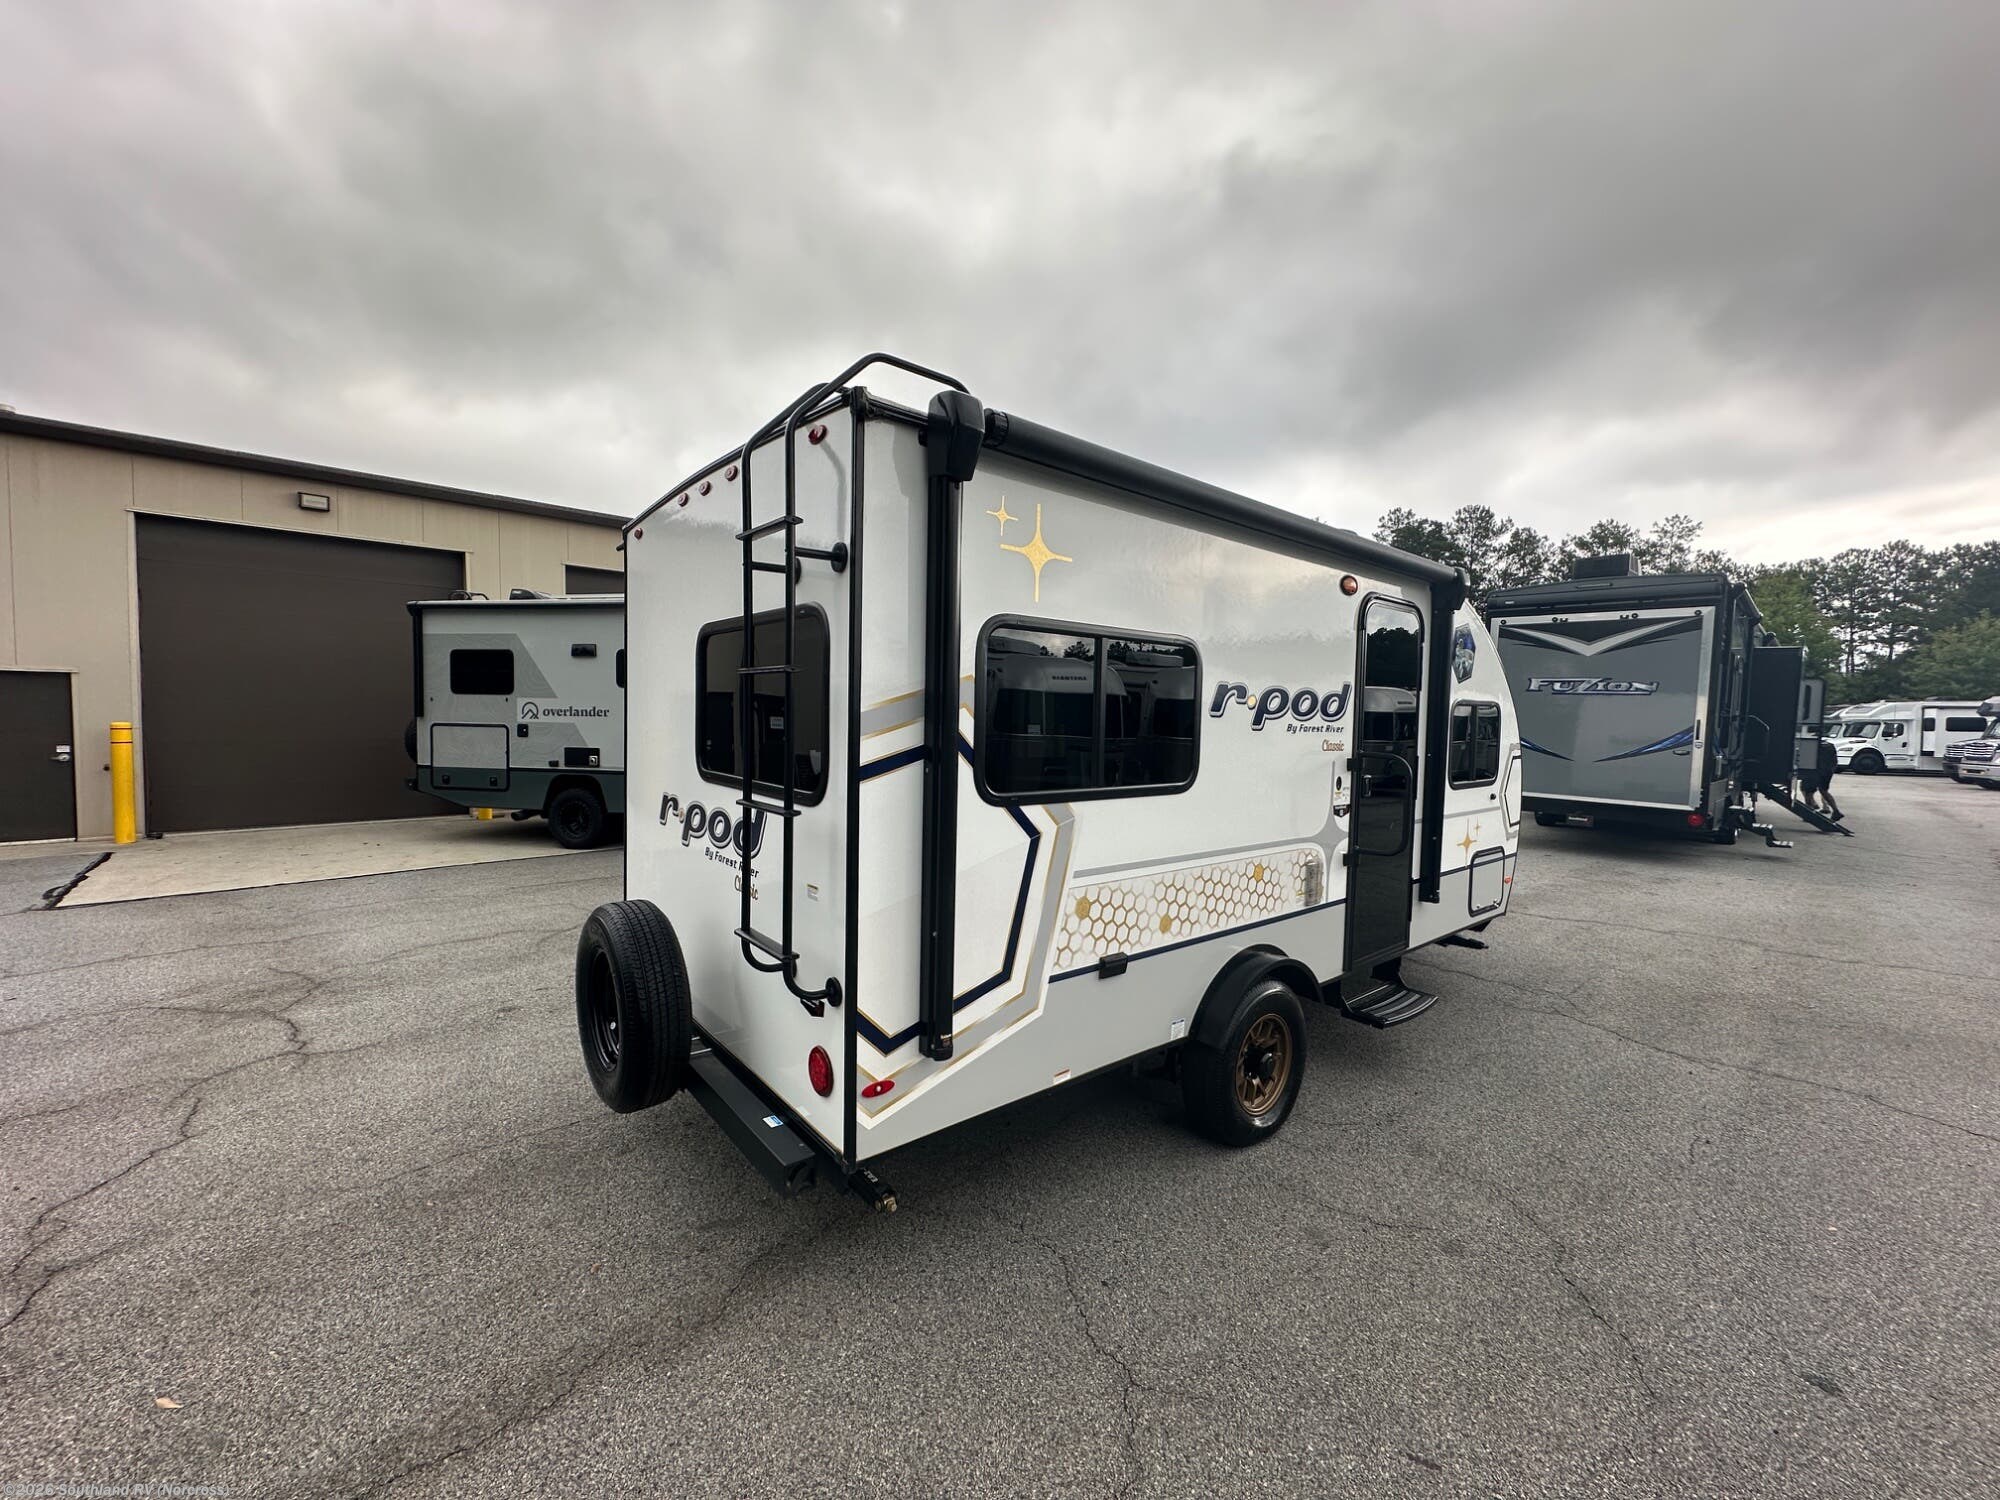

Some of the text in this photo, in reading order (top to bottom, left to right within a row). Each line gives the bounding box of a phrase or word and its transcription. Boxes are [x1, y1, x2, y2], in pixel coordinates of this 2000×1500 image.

[1526, 677, 1660, 695] FUZION
[542, 706, 610, 717] overlander
[1286, 723, 1344, 734] By Forest River
[1321, 739, 1345, 752] Classic
[705, 846, 714, 860] By
[715, 851, 737, 868] Forest
